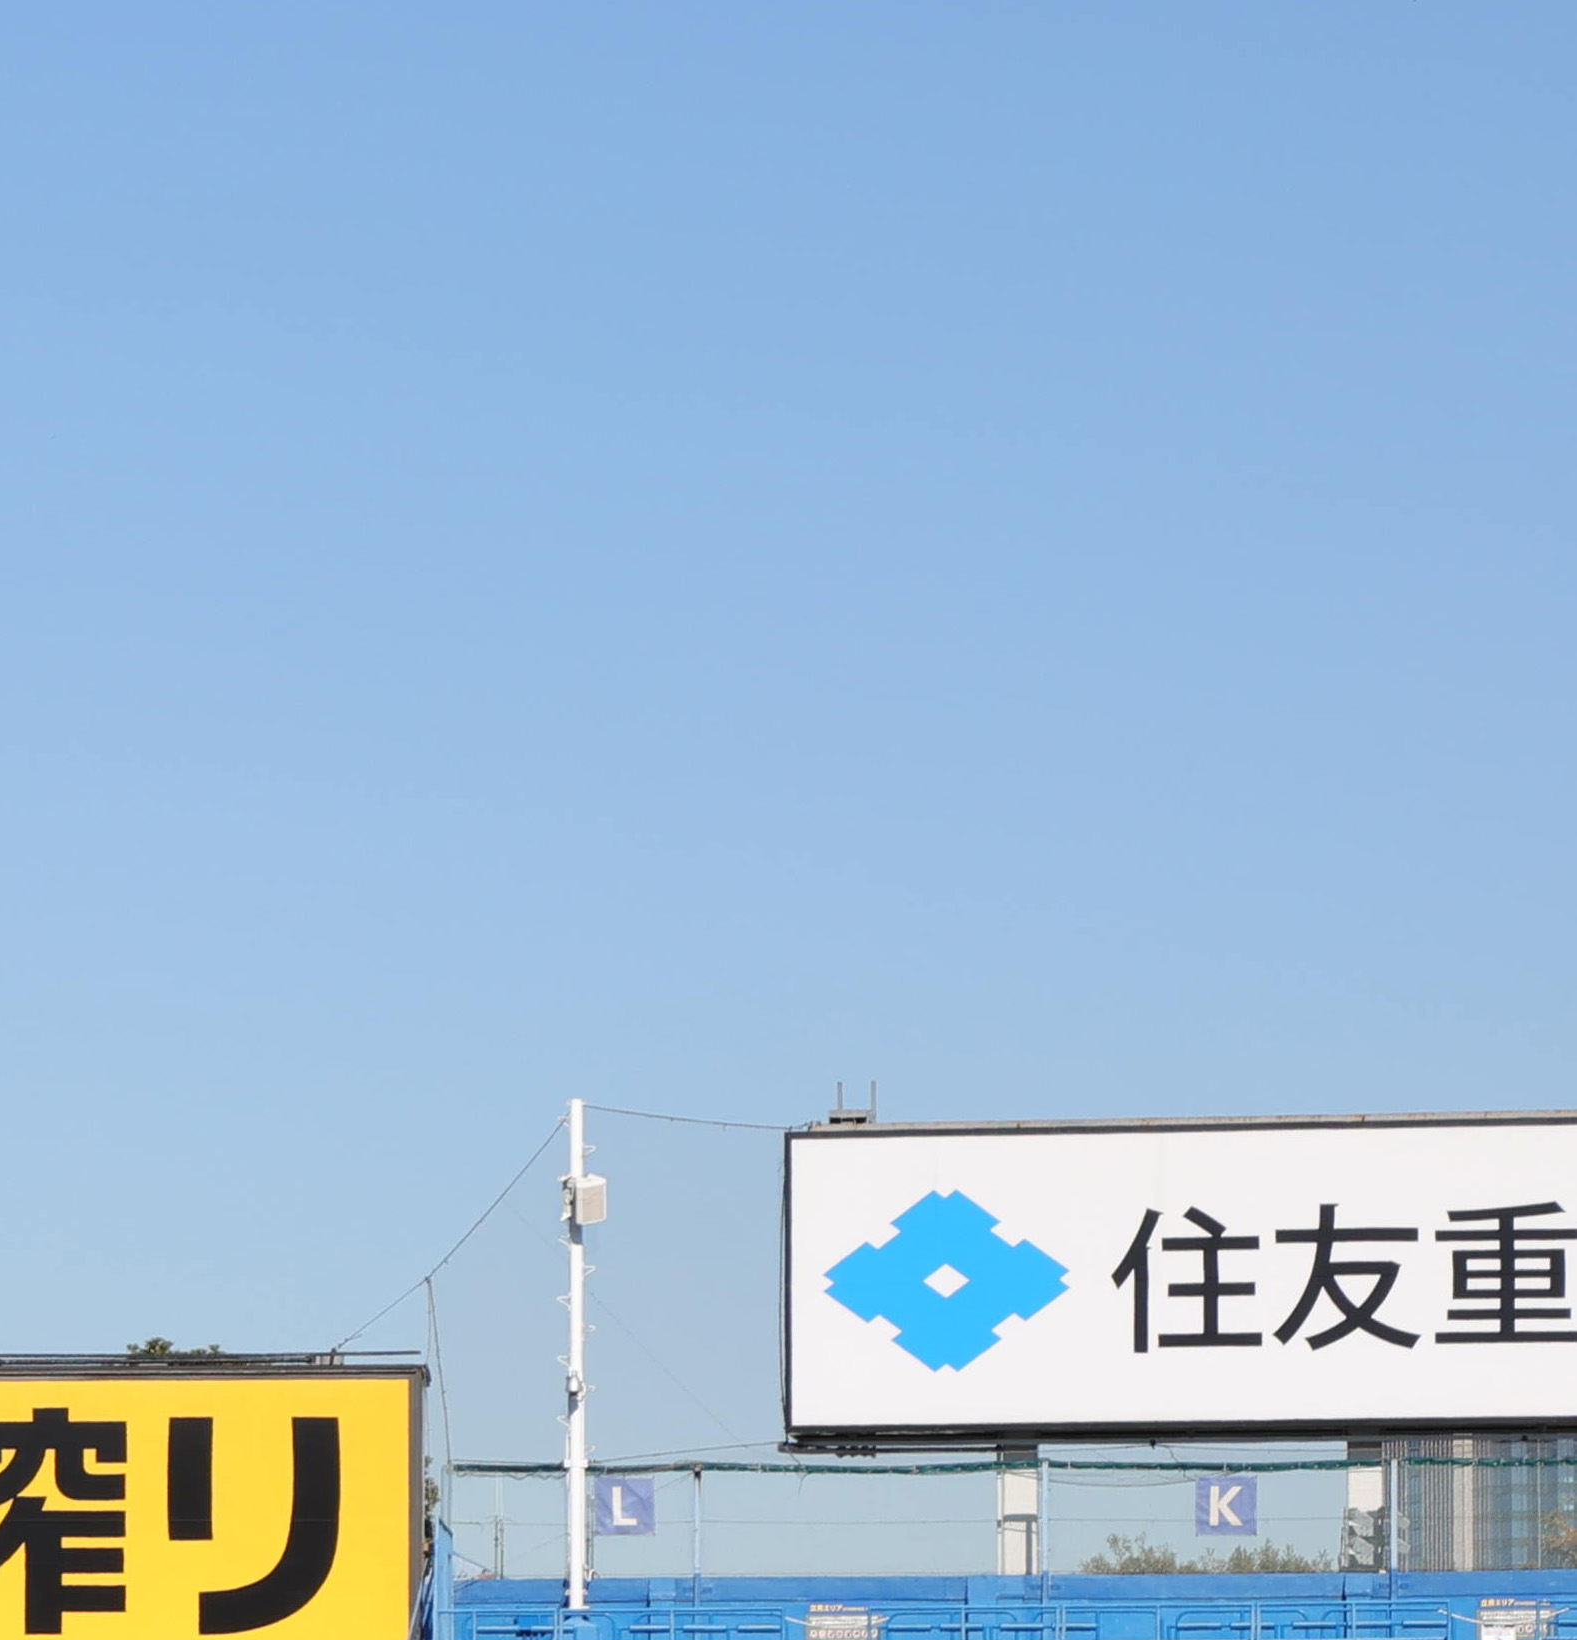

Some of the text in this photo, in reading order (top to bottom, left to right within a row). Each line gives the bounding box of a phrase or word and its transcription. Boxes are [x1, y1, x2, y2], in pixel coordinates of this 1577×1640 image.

[1111, 1201, 1577, 1353] 住友重
[611, 1493, 637, 1527] L
[1208, 1487, 1243, 1527] K
